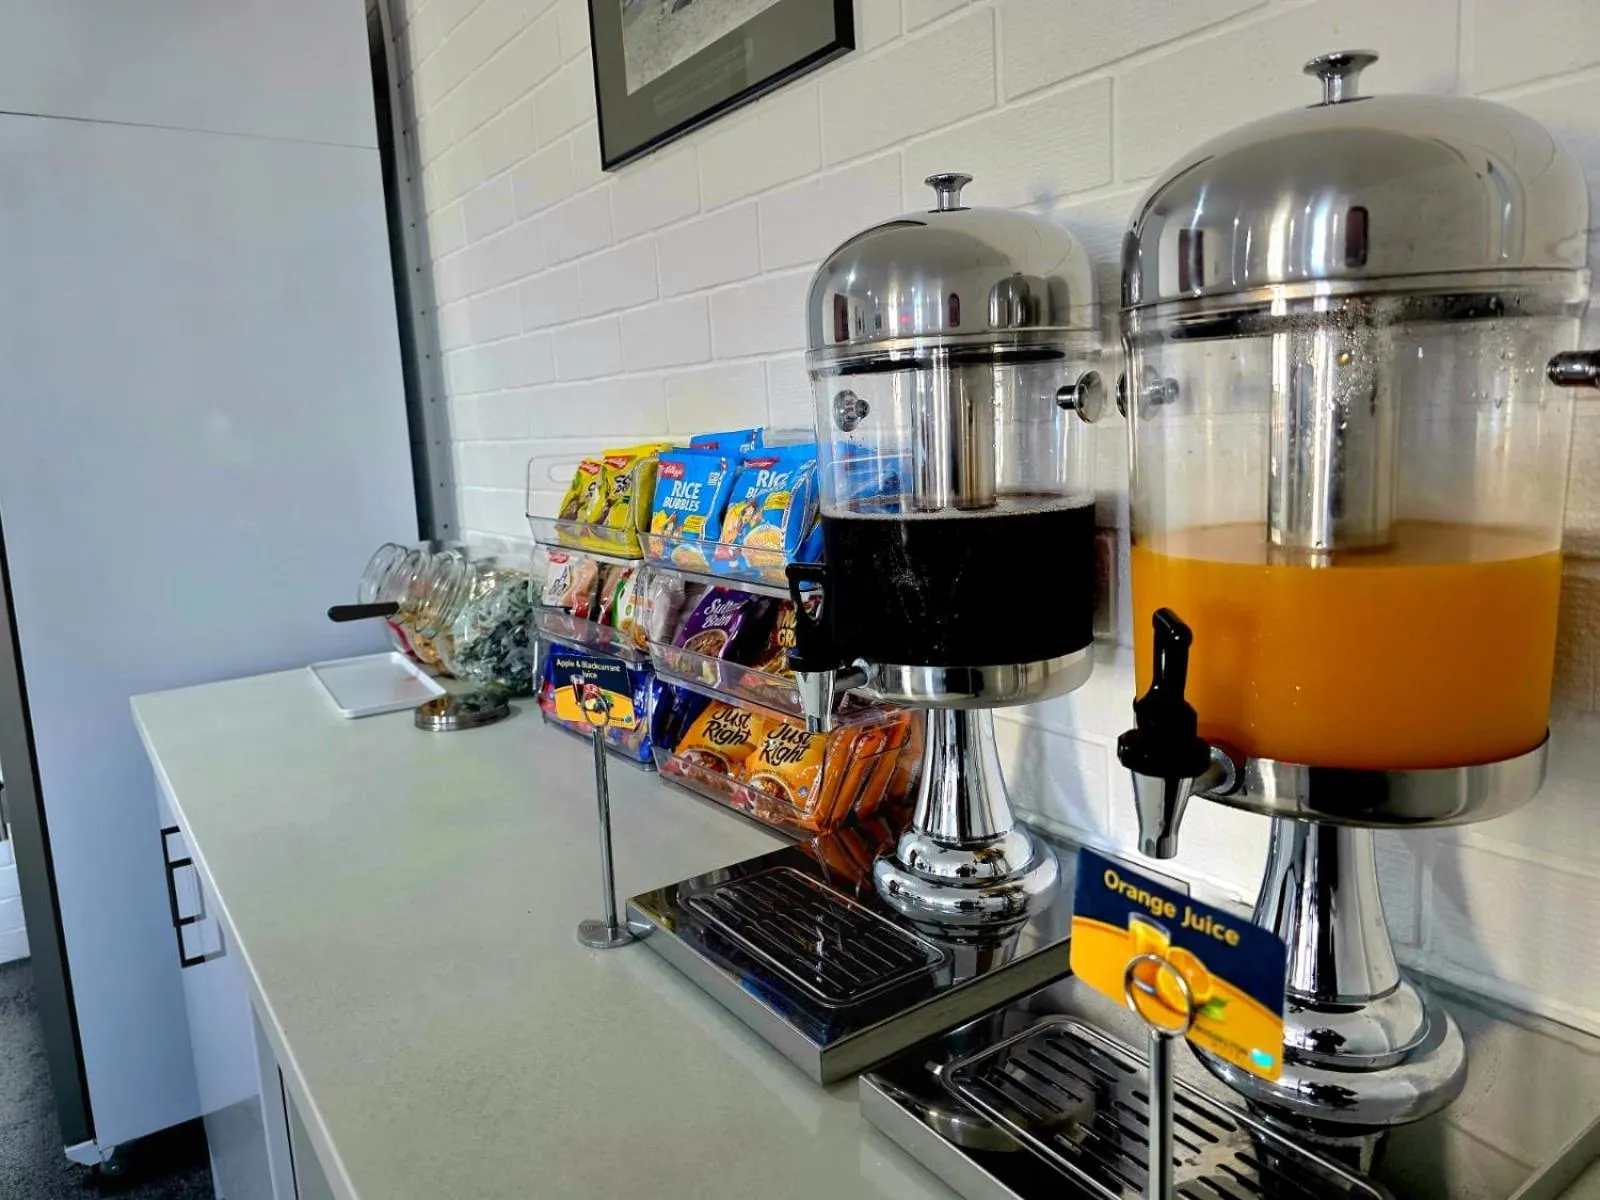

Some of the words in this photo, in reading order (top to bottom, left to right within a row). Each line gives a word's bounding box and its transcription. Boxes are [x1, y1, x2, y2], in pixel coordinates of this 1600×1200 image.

[671, 480, 703, 499] RICE
[662, 496, 701, 512] BUBBLES
[556, 657, 575, 668] Apple
[575, 660, 581, 668] &
[581, 660, 621, 673] Blackcurrant
[582, 669, 598, 679] Juice
[702, 720, 752, 745] Right
[759, 740, 811, 766] Right
[1103, 868, 1177, 919] Orange
[1180, 906, 1241, 947] Juice
